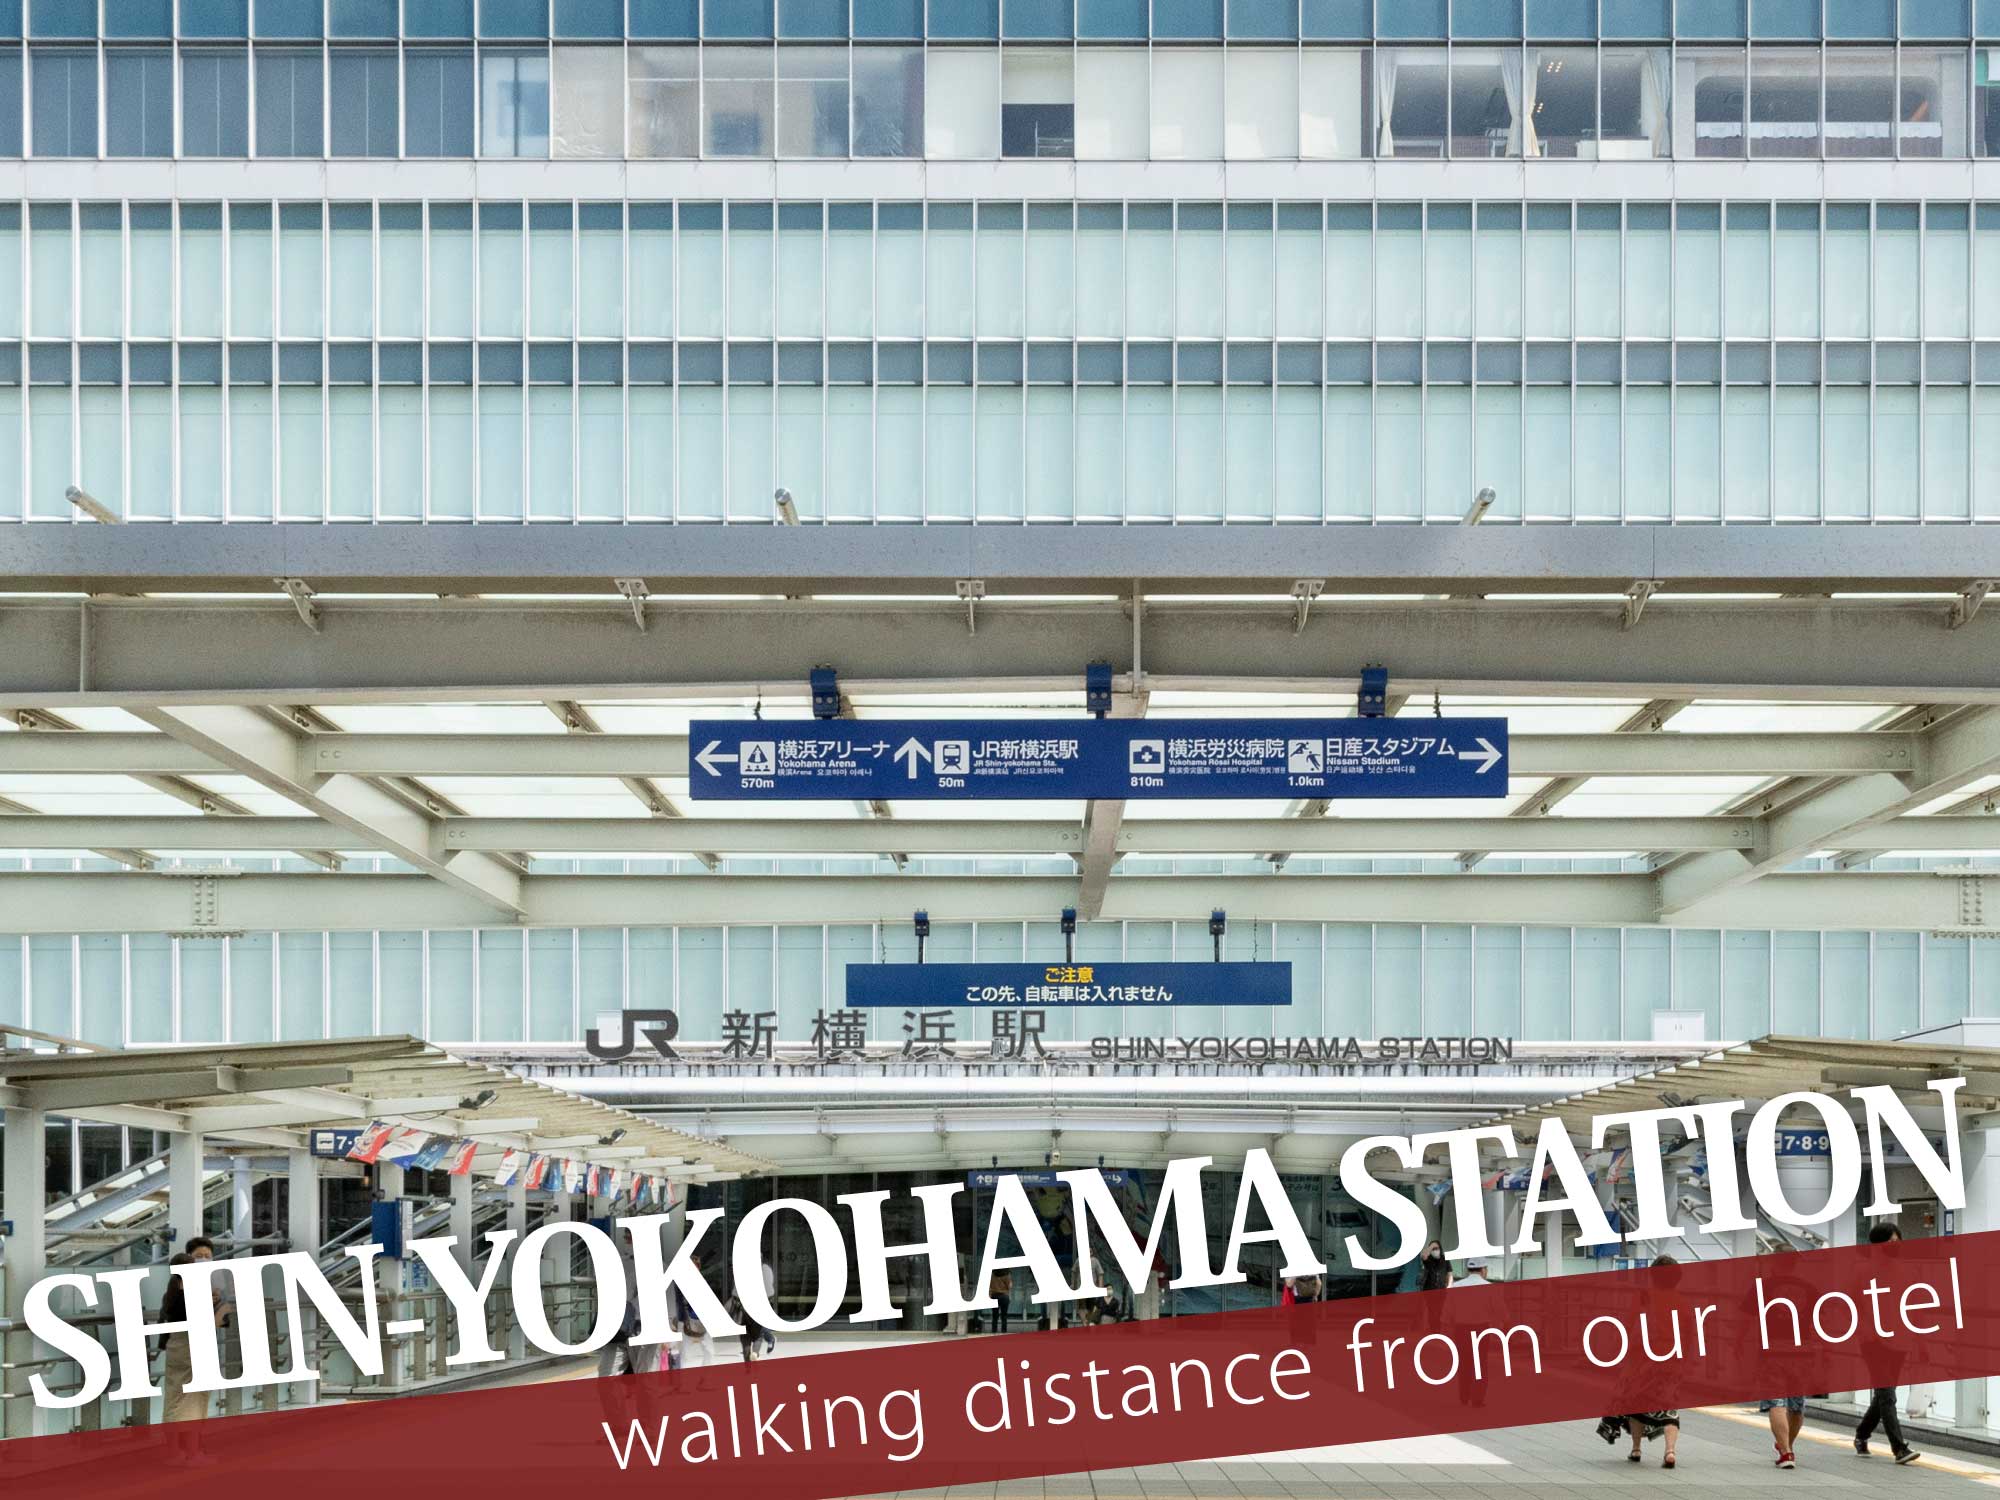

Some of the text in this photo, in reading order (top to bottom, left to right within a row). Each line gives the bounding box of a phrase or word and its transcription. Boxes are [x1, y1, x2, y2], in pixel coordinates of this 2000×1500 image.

[778, 740, 891, 759] 横浜アリーナ
[972, 739, 1079, 759] JR新横浜駅
[1168, 739, 1285, 758] 横浜労災病院
[1326, 737, 1456, 757] 日産スタジアム
[778, 760, 857, 768] Yokohama Arena
[985, 760, 1041, 768] Shin-yokohama
[1168, 759, 1207, 767] Yokohama
[1232, 759, 1263, 768] Hospital
[1326, 757, 1400, 766] Nissan Stadium
[741, 778, 774, 788] 570m
[938, 777, 965, 788] 50m
[1130, 776, 1164, 787] 810m
[1288, 776, 1325, 787] 1.0km
[1045, 967, 1094, 984] ご注意
[966, 985, 1174, 1002] この先、自転車は入れません
[586, 1009, 1047, 1060] JR 新横浜駅
[1091, 1036, 1513, 1060] SHIN-YOKOHAMA STATION
